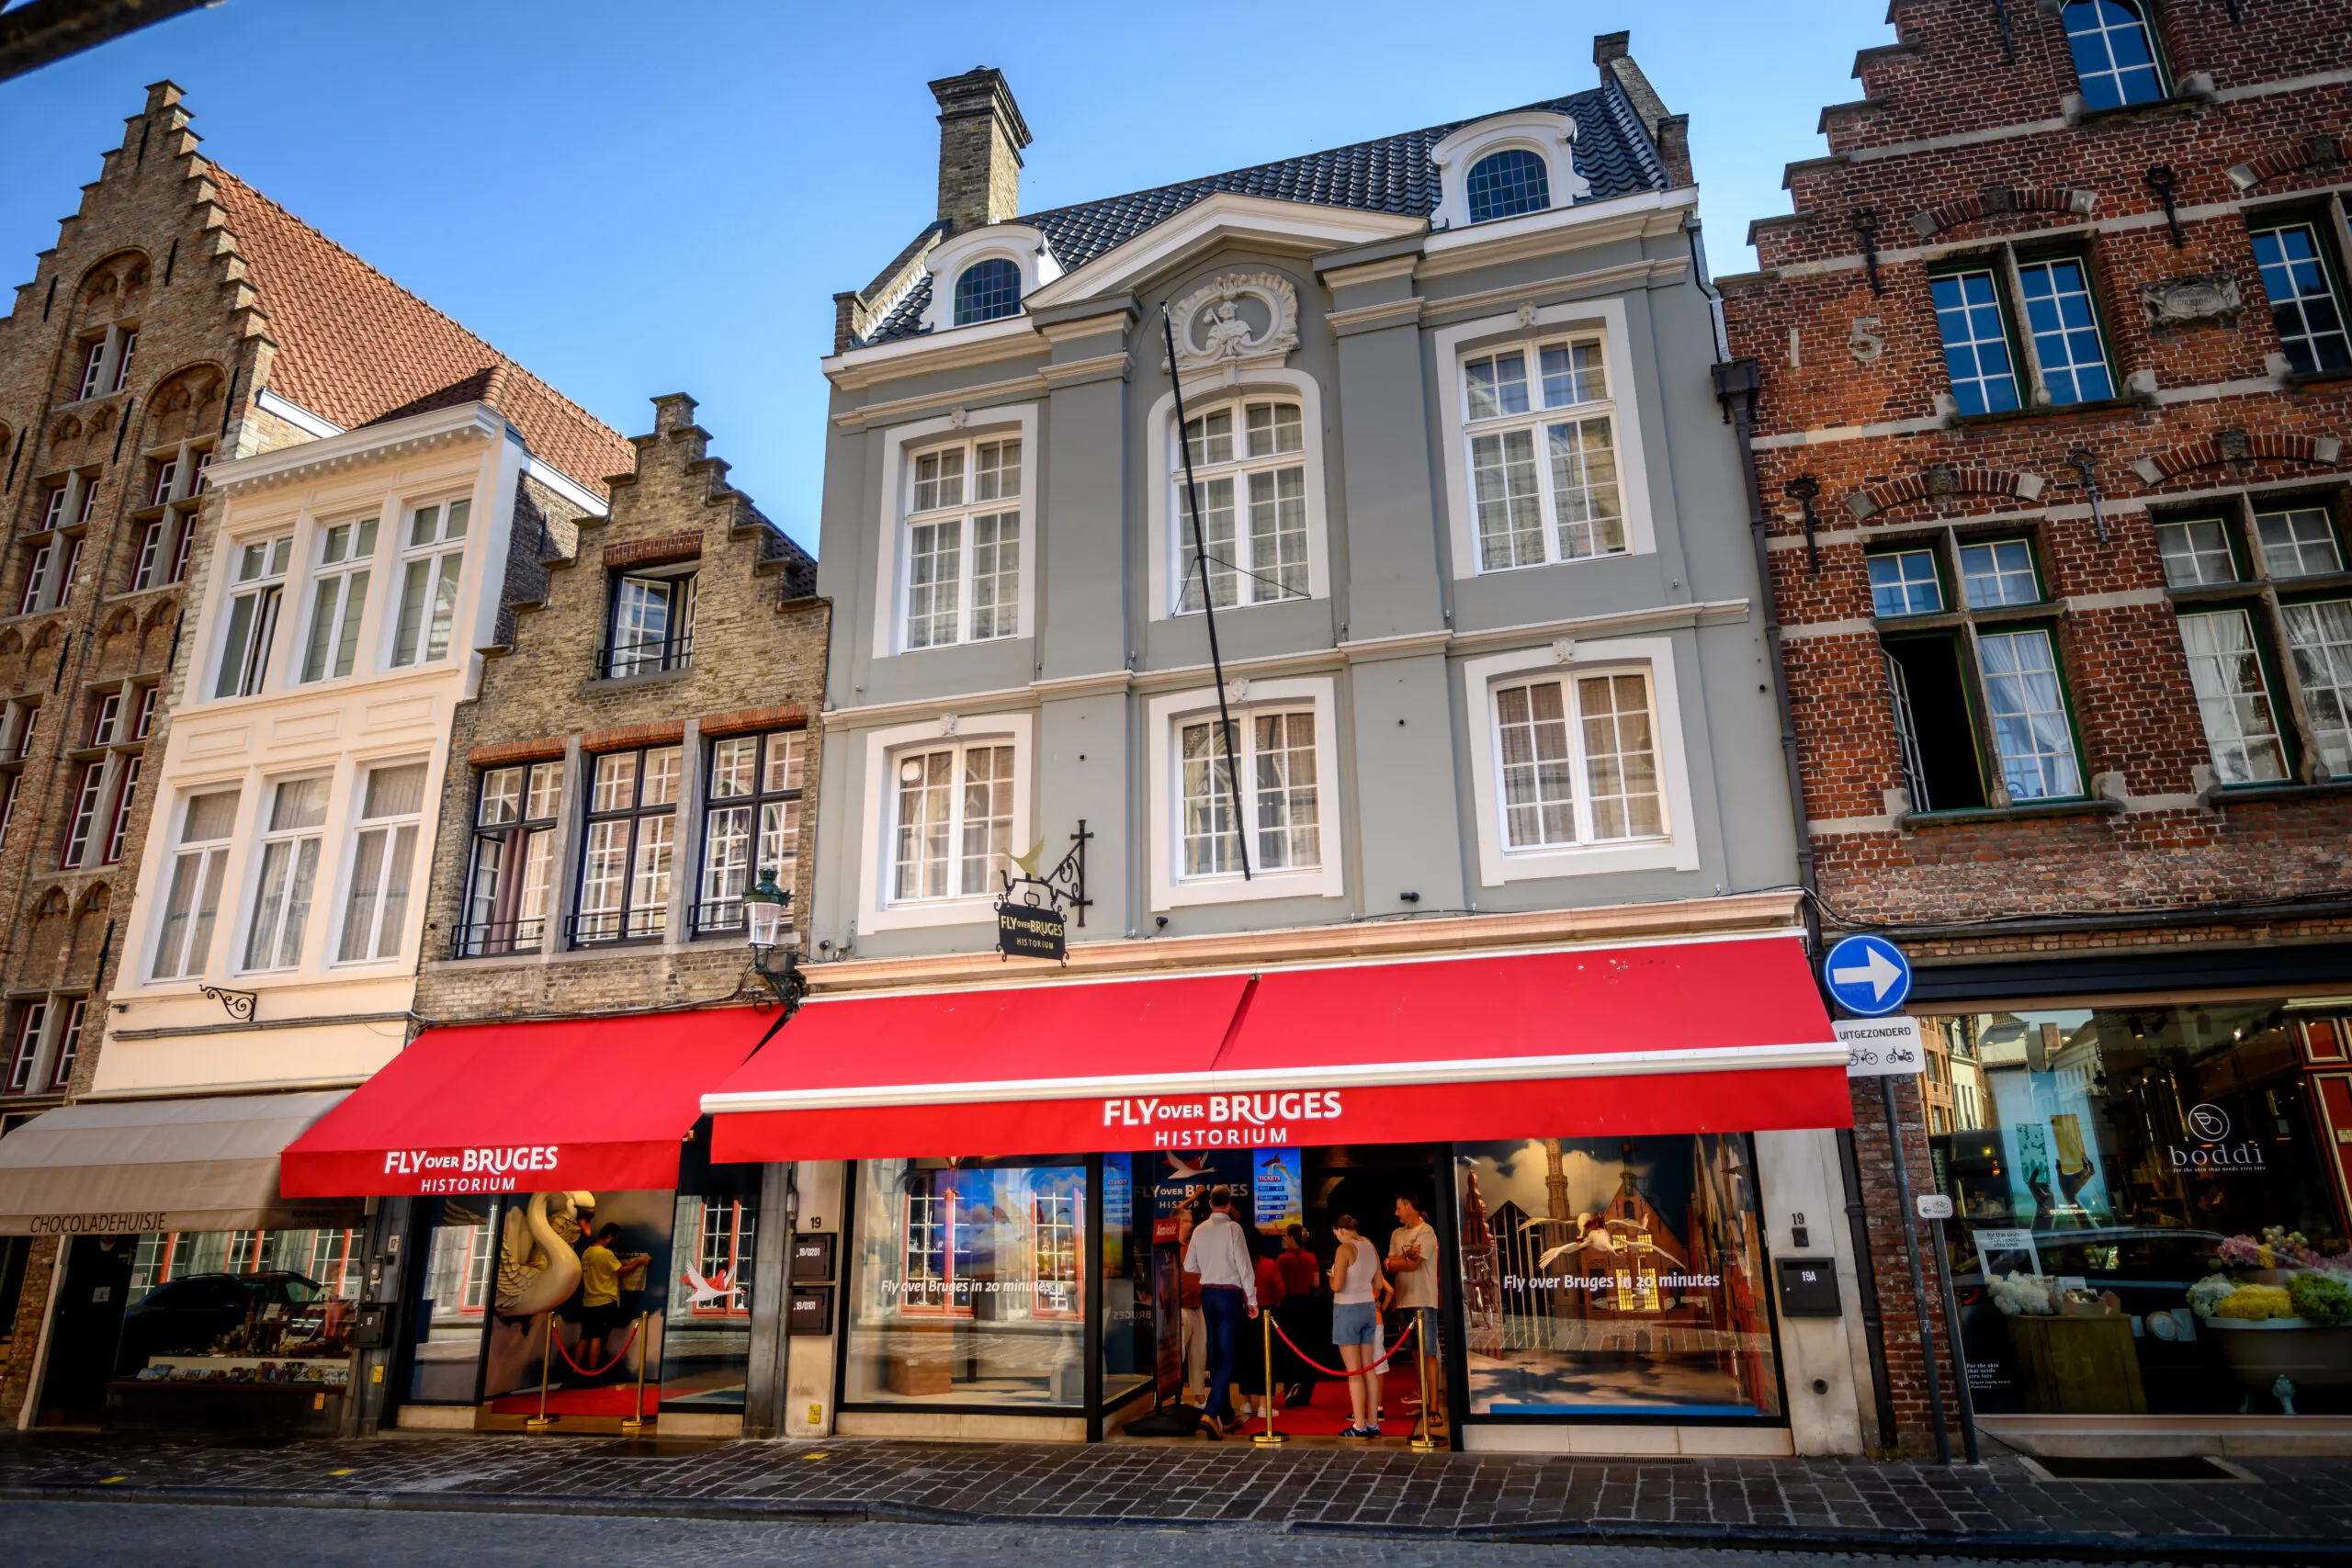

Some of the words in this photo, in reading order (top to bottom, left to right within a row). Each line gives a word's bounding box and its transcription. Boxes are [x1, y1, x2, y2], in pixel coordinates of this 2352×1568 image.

[1851, 316, 1883, 360] 5
[1001, 915, 1017, 931] FLY
[1016, 921, 1031, 930] OVER
[1030, 919, 1064, 937] BRUGES
[1016, 937, 1054, 950] HISTORIUM
[1838, 1026, 1912, 1040] UITGEZONDERD
[1103, 1098, 1159, 1126] FLY
[1158, 1104, 1204, 1119] OVER
[1209, 1090, 1342, 1125] BRUGES
[1155, 1126, 1287, 1147] HISTORIUM
[384, 1150, 428, 1174] FLY
[424, 1156, 459, 1168] OVER
[461, 1145, 559, 1175] BRUGES
[2168, 1143, 2265, 1166] boddi
[421, 1177, 515, 1192] HISTORIUM
[1160, 1187, 1183, 1195] OVER
[30, 1212, 167, 1234] CHOCOLADEHUISJE
[810, 1216, 822, 1229] 19
[1792, 1212, 1805, 1225] 19
[390, 1238, 397, 1249] 17
[1503, 1275, 1526, 1289] Fly
[1529, 1278, 1561, 1289] over
[1564, 1274, 1614, 1292] Bruges
[1617, 1273, 1633, 1288] in
[1635, 1276, 1655, 1289] 20
[1658, 1271, 1721, 1288] minutes
[1802, 1270, 1816, 1281] 19A
[881, 1280, 899, 1295] Fly
[901, 1281, 925, 1292] over
[928, 1280, 968, 1294] Bruges
[971, 1279, 982, 1292] in
[985, 1282, 1001, 1292] 20
[1003, 1278, 1052, 1292] minutes
